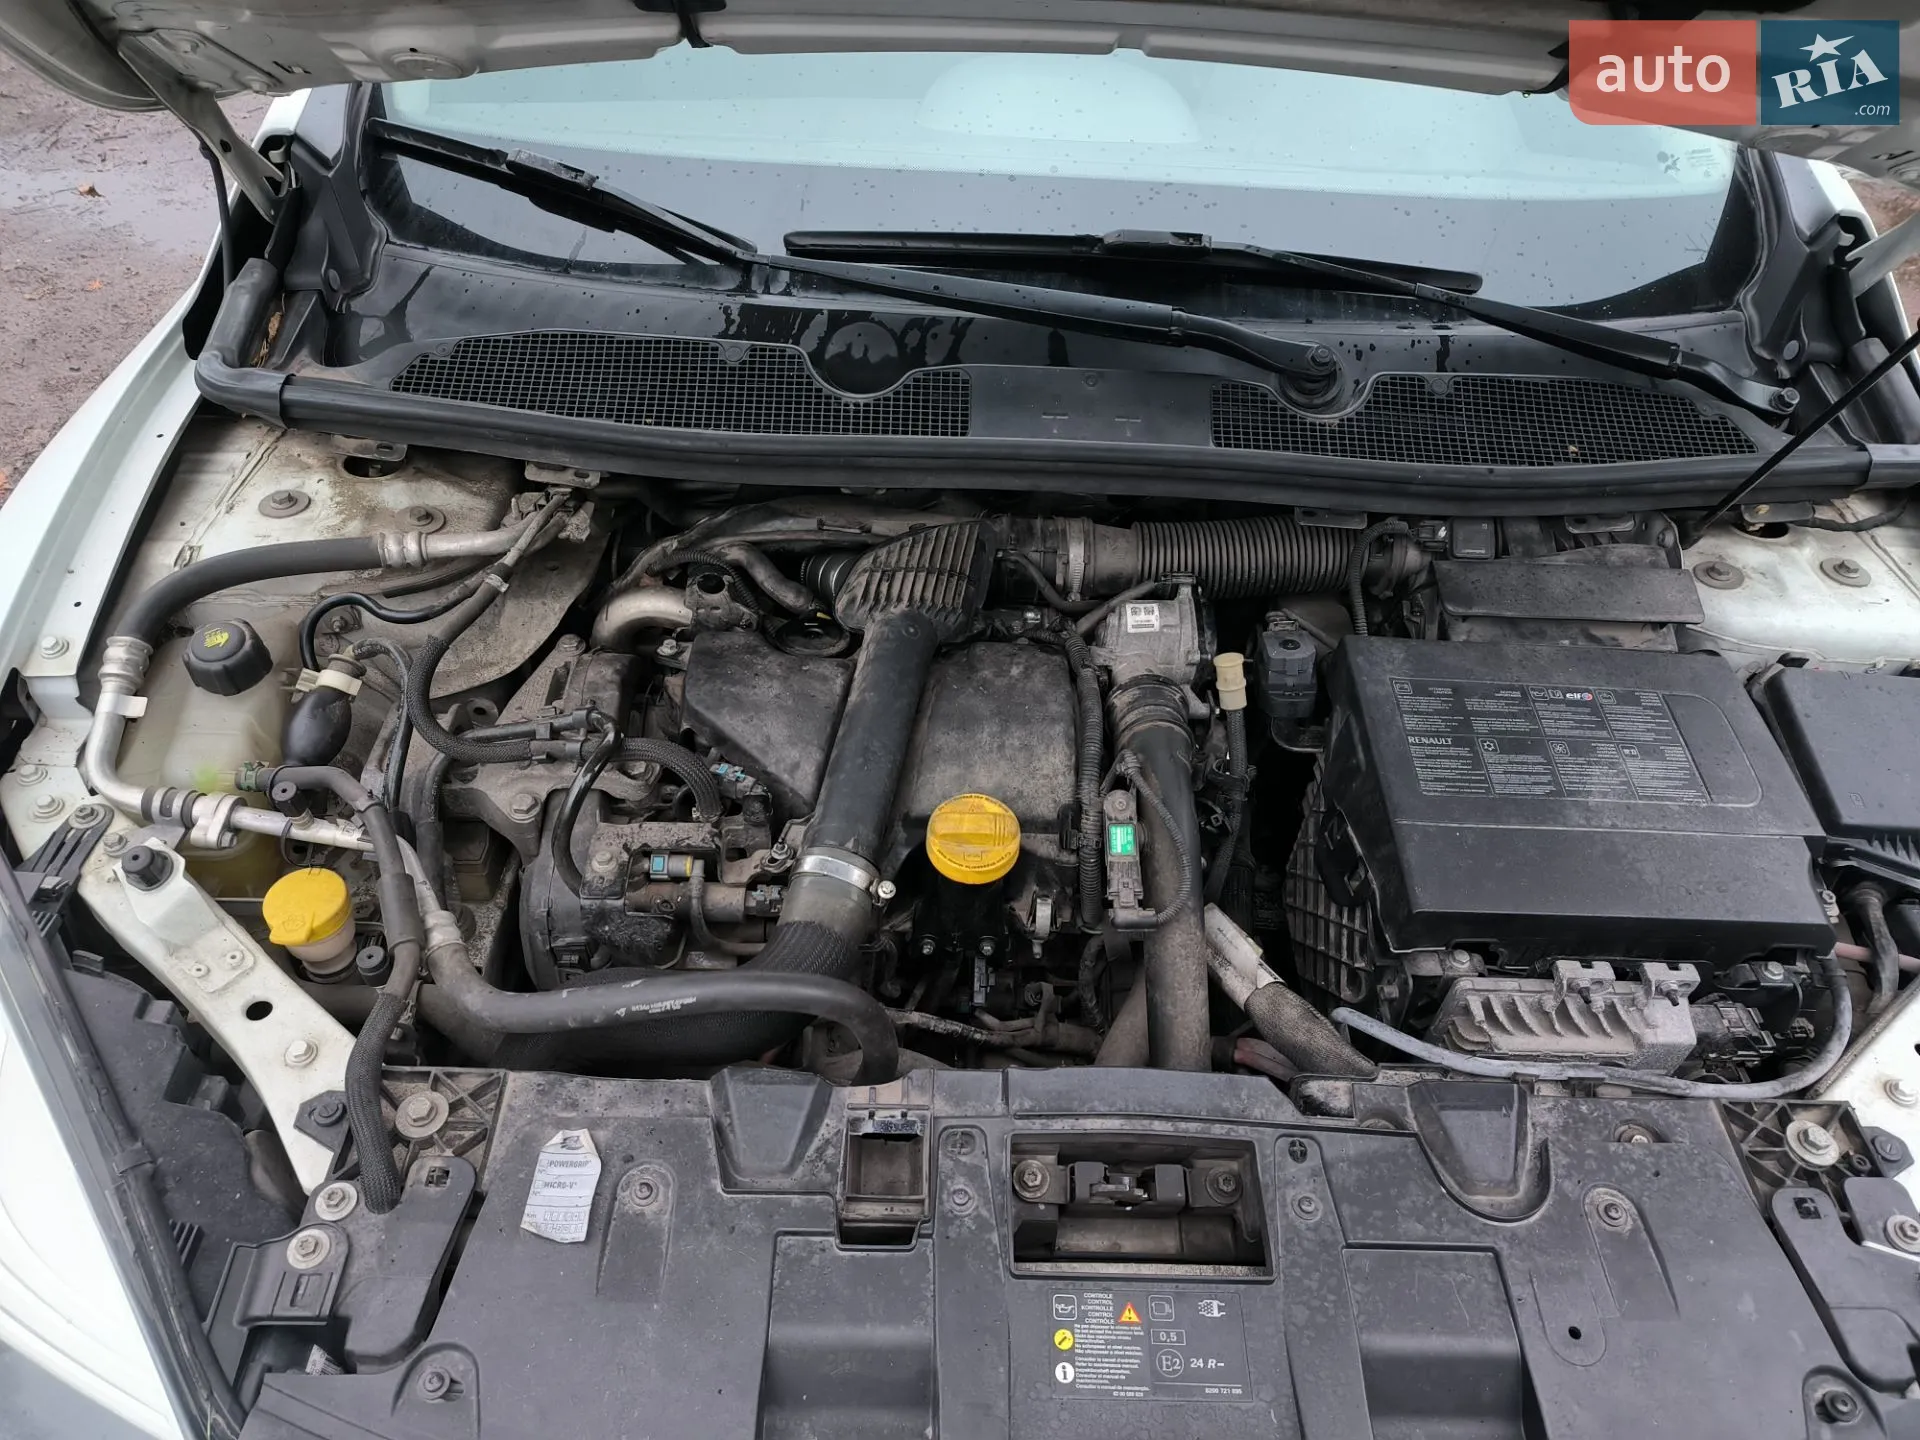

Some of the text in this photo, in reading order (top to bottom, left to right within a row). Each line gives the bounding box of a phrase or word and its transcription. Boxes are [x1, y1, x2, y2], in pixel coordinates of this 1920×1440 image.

[1408, 736, 1452, 745] RENAULT
[1160, 1332, 1177, 1342] 0,5
[1161, 1355, 1181, 1371] E2
[1190, 1358, 1204, 1368] 24
